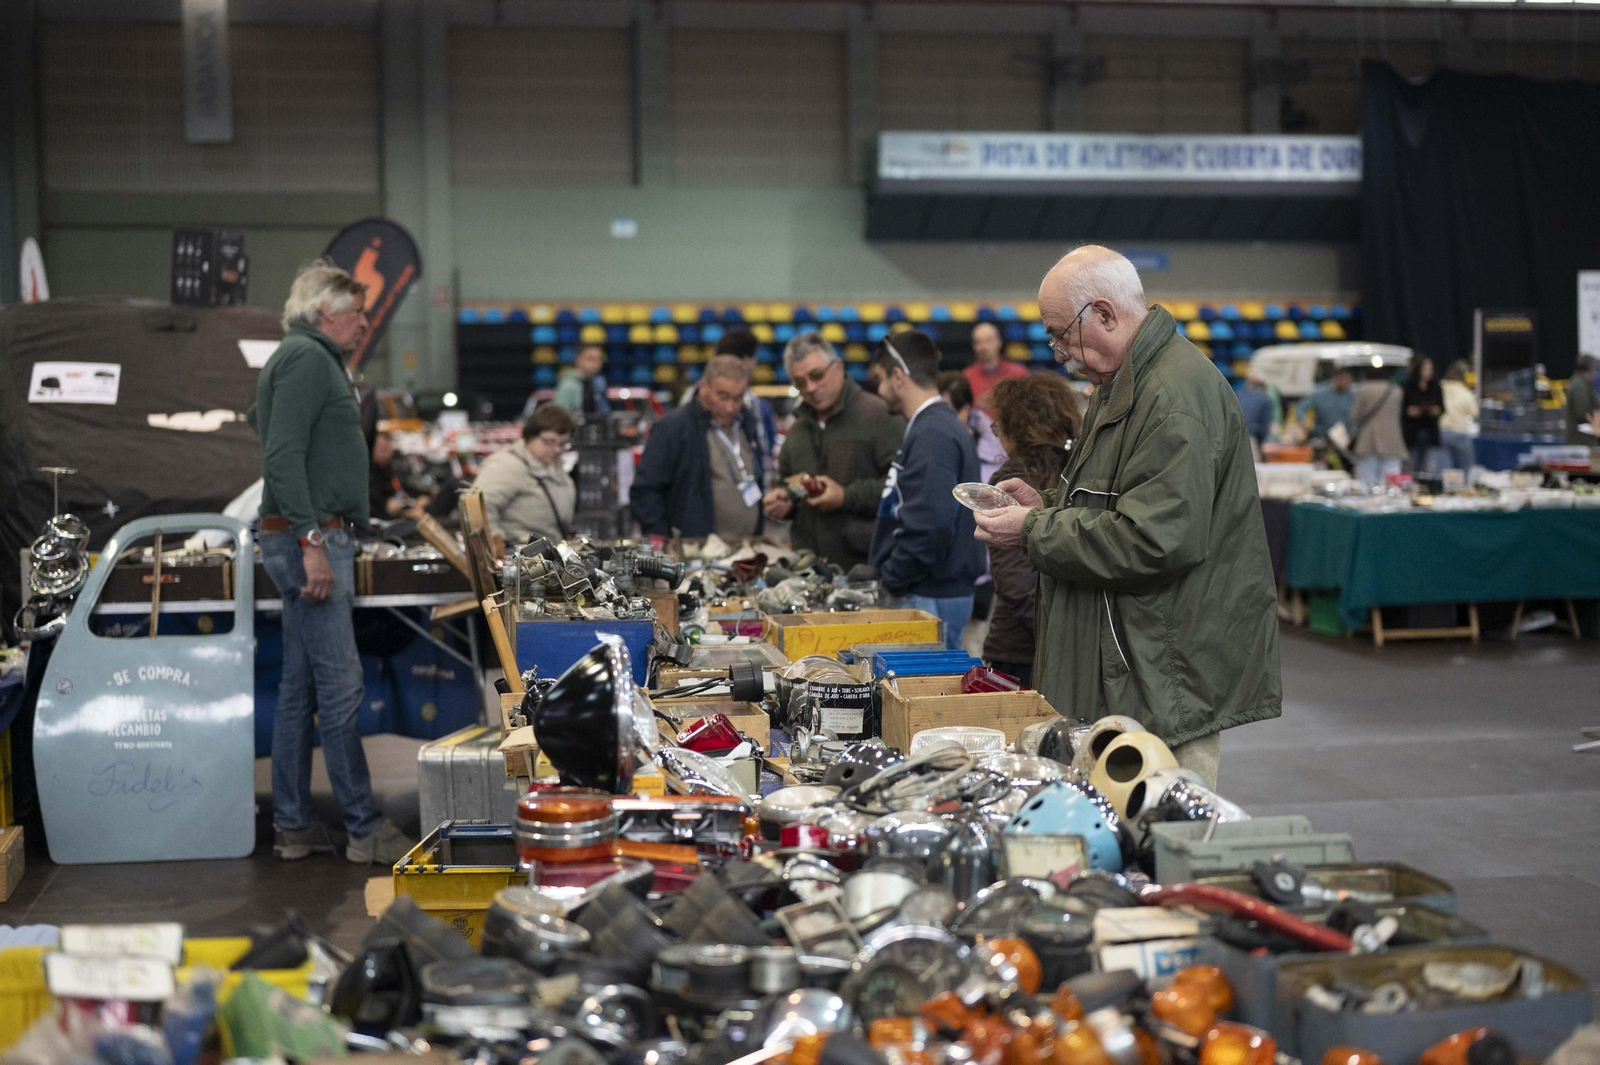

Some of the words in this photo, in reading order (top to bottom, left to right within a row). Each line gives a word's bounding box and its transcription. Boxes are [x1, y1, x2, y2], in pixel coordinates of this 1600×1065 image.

[980, 143, 1037, 166] PISTA
[1045, 143, 1070, 167] DE
[1078, 143, 1187, 168] ATLETISMO
[1193, 144, 1281, 169] CUBERTA
[1288, 145, 1312, 169] DE
[113, 669, 132, 686] SE
[138, 666, 190, 686] COMPRA
